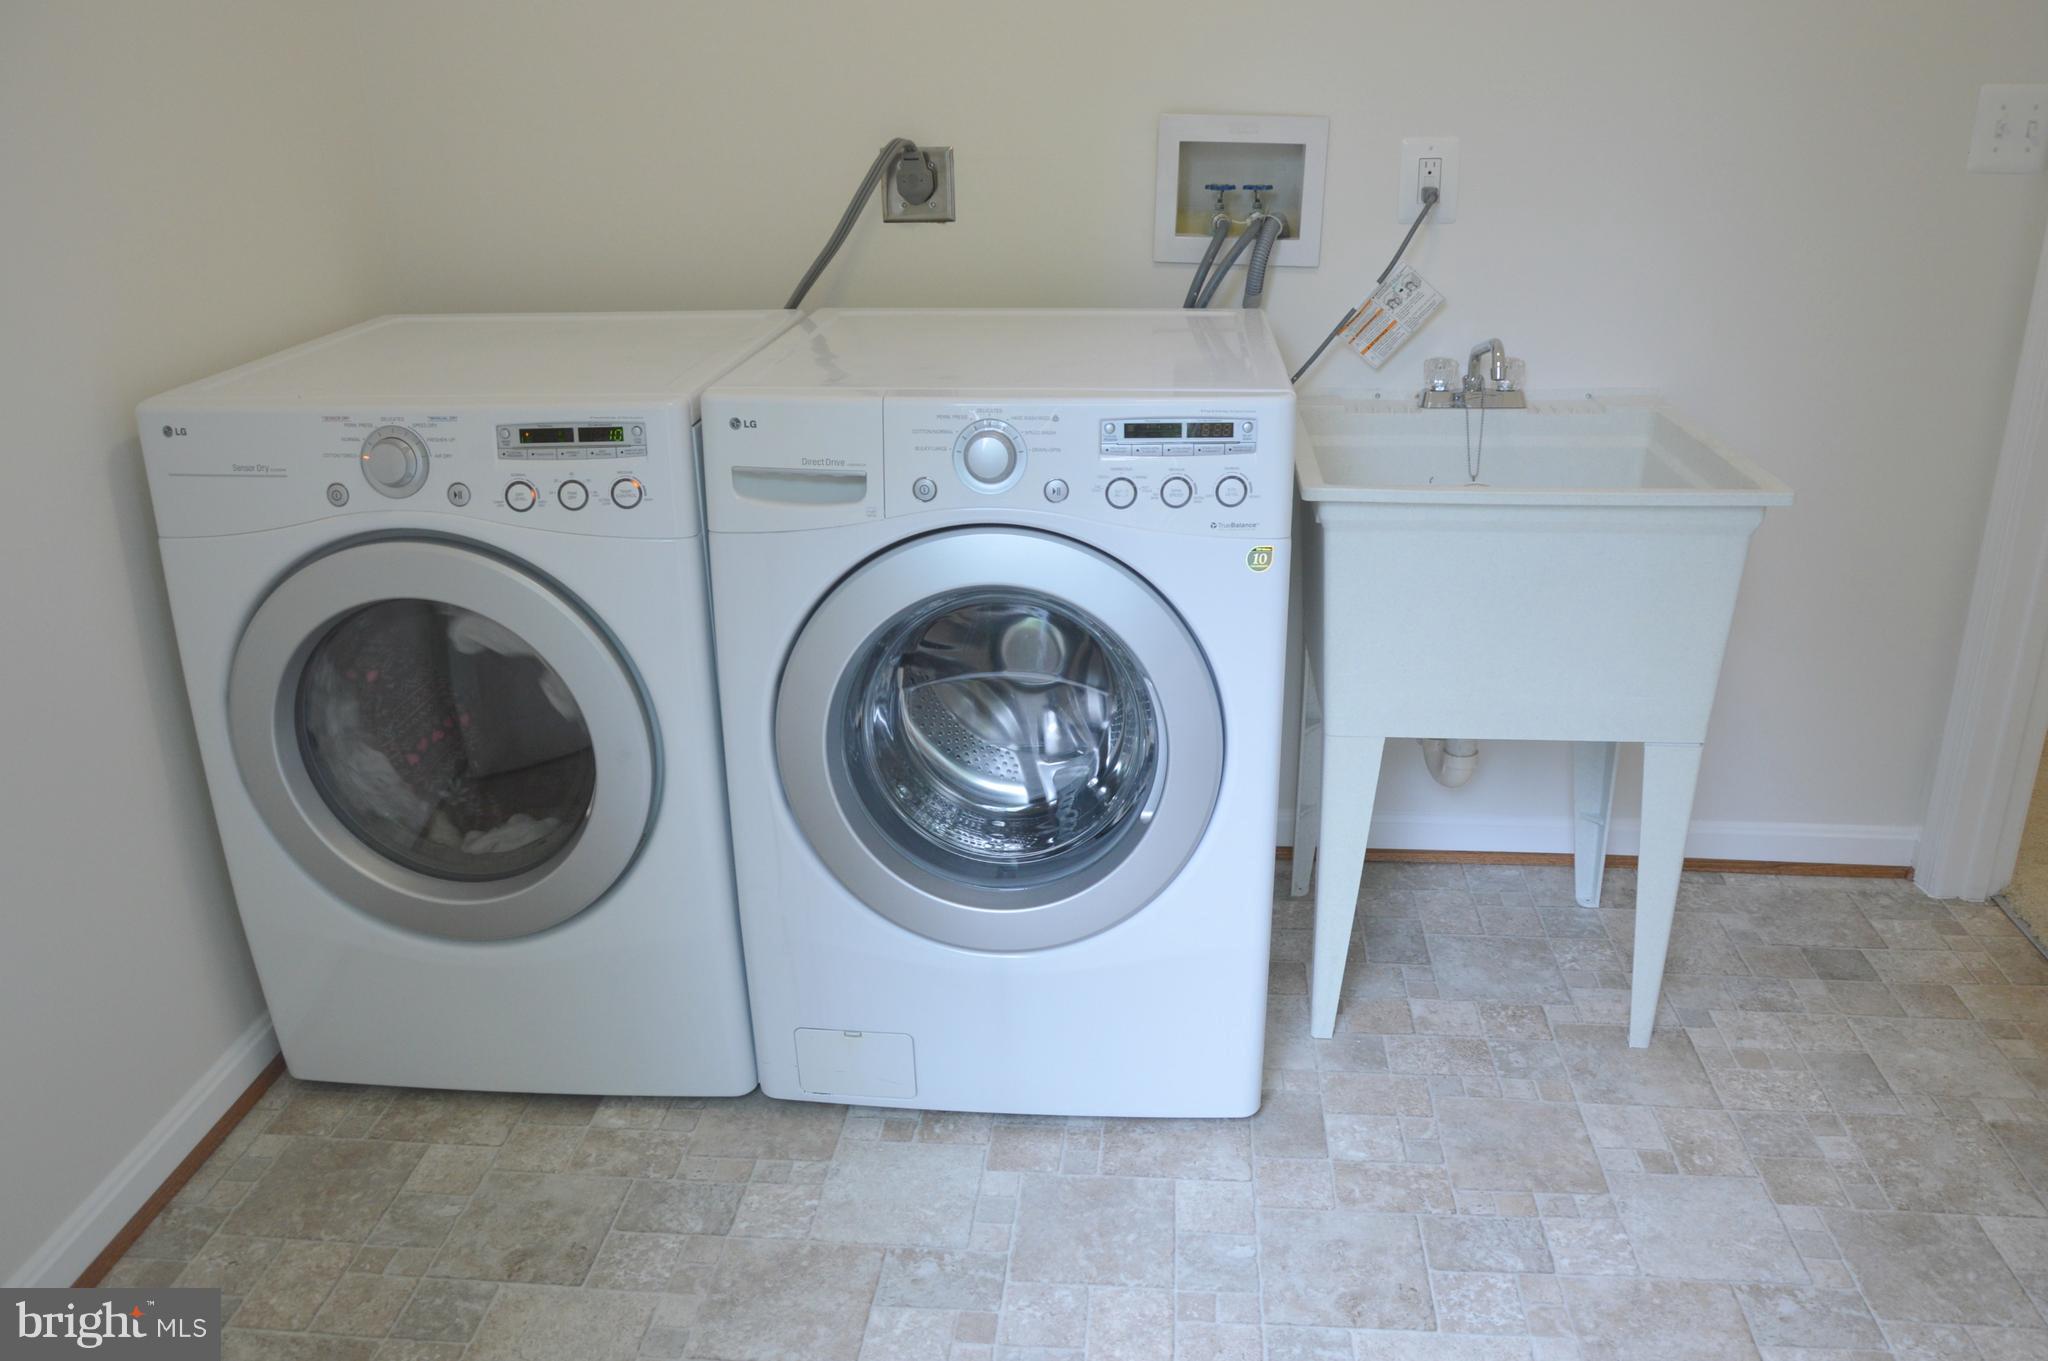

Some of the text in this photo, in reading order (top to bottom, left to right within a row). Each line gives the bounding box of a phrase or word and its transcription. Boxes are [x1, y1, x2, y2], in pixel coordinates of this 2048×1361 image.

[744, 420, 757, 429] LG
[175, 427, 187, 437] LG
[232, 463, 255, 472] Sensor
[256, 463, 270, 473] Dry
[1253, 553, 1267, 565] 10
